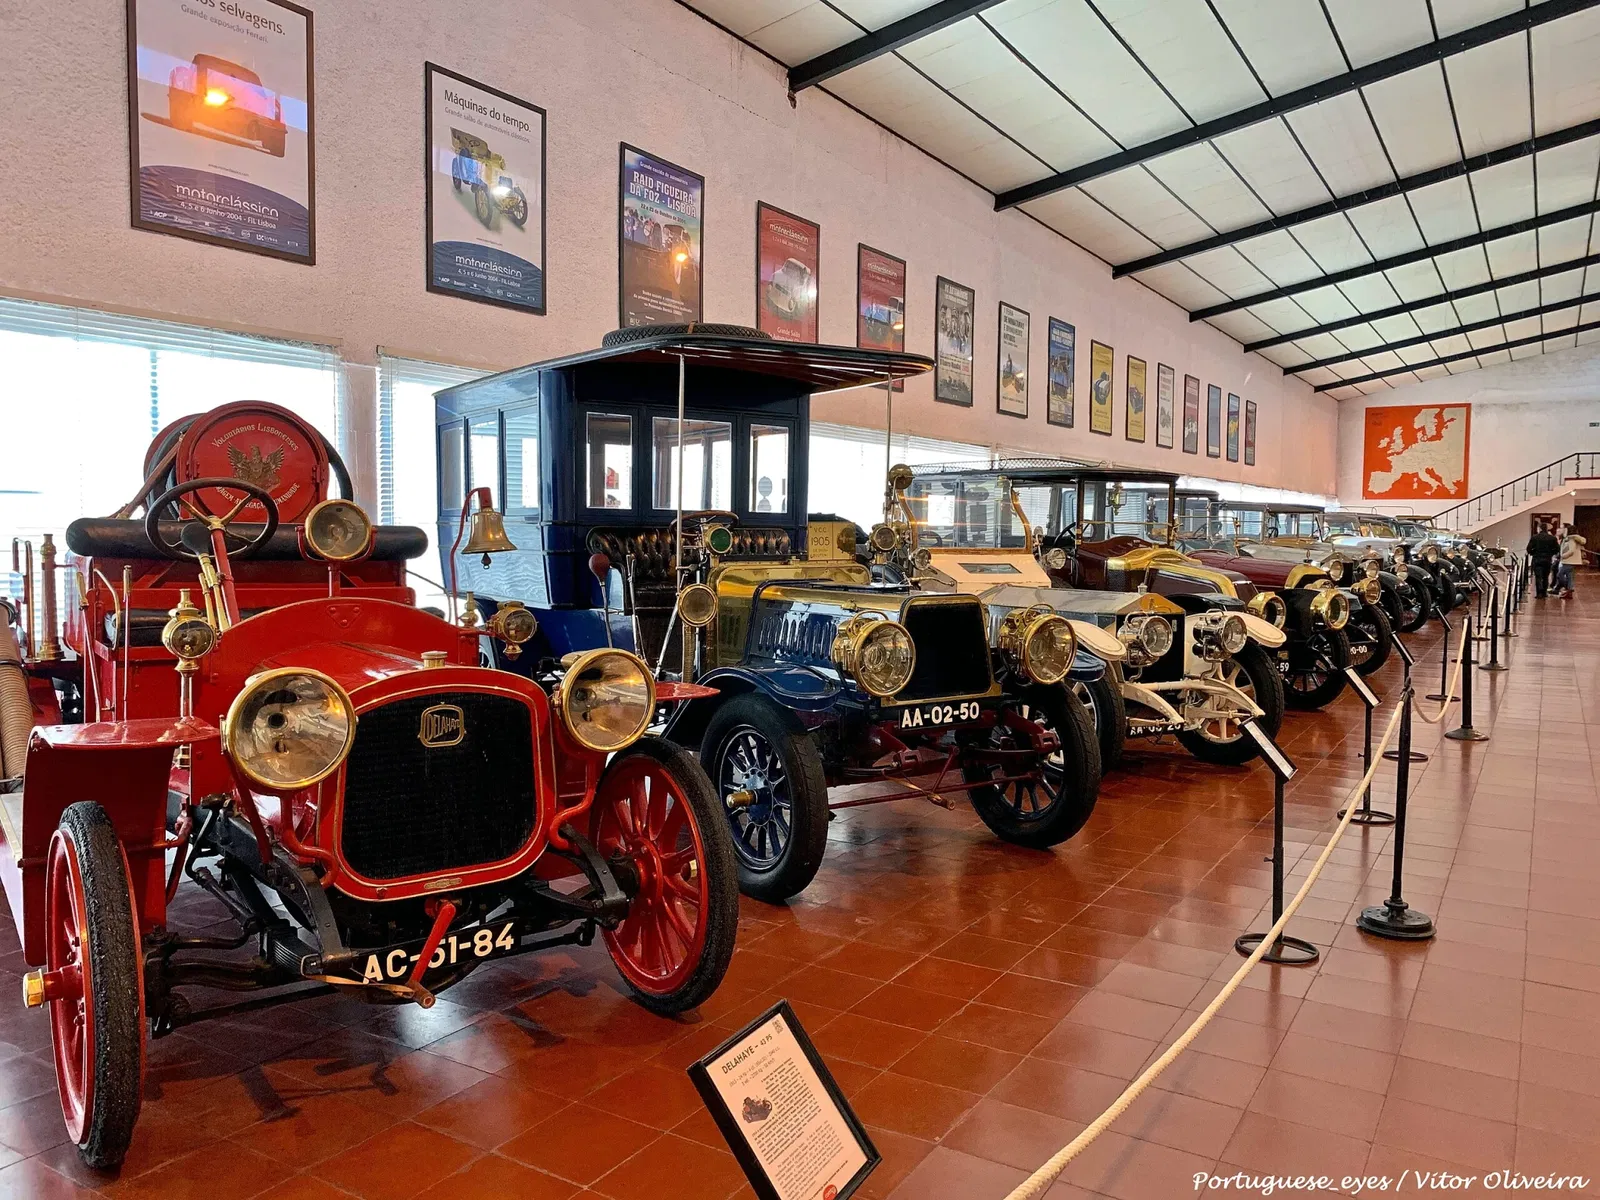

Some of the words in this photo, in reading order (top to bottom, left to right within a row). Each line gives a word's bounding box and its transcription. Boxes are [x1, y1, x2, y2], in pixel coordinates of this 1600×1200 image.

[181, 3, 208, 21] Grande
[209, 15, 245, 34] exposição
[245, 28, 269, 44] Ferrari.
[219, 1, 286, 36] selvagens.
[444, 89, 488, 117] Máquinas
[489, 107, 501, 121] do
[502, 112, 532, 133] tempo.
[444, 106, 463, 119] Grande
[176, 184, 279, 219] motorclássico
[629, 182, 642, 197] DA
[643, 188, 660, 204] FOZ
[667, 196, 697, 218] LISBOA
[633, 170, 654, 190] RAID
[656, 180, 693, 205] FIGUEIRA
[206, 207, 226, 218] Junho
[226, 211, 243, 221] 2004
[257, 219, 277, 230] Lisboa
[455, 255, 523, 279] motorclássico
[257, 422, 299, 451] LISBONENSES
[811, 536, 830, 546] 1905
[901, 701, 980, 728] AA-02-50
[362, 922, 515, 985] AC-51-84
[721, 1045, 755, 1075] DELAHAYE
[760, 1038, 767, 1046] 43
